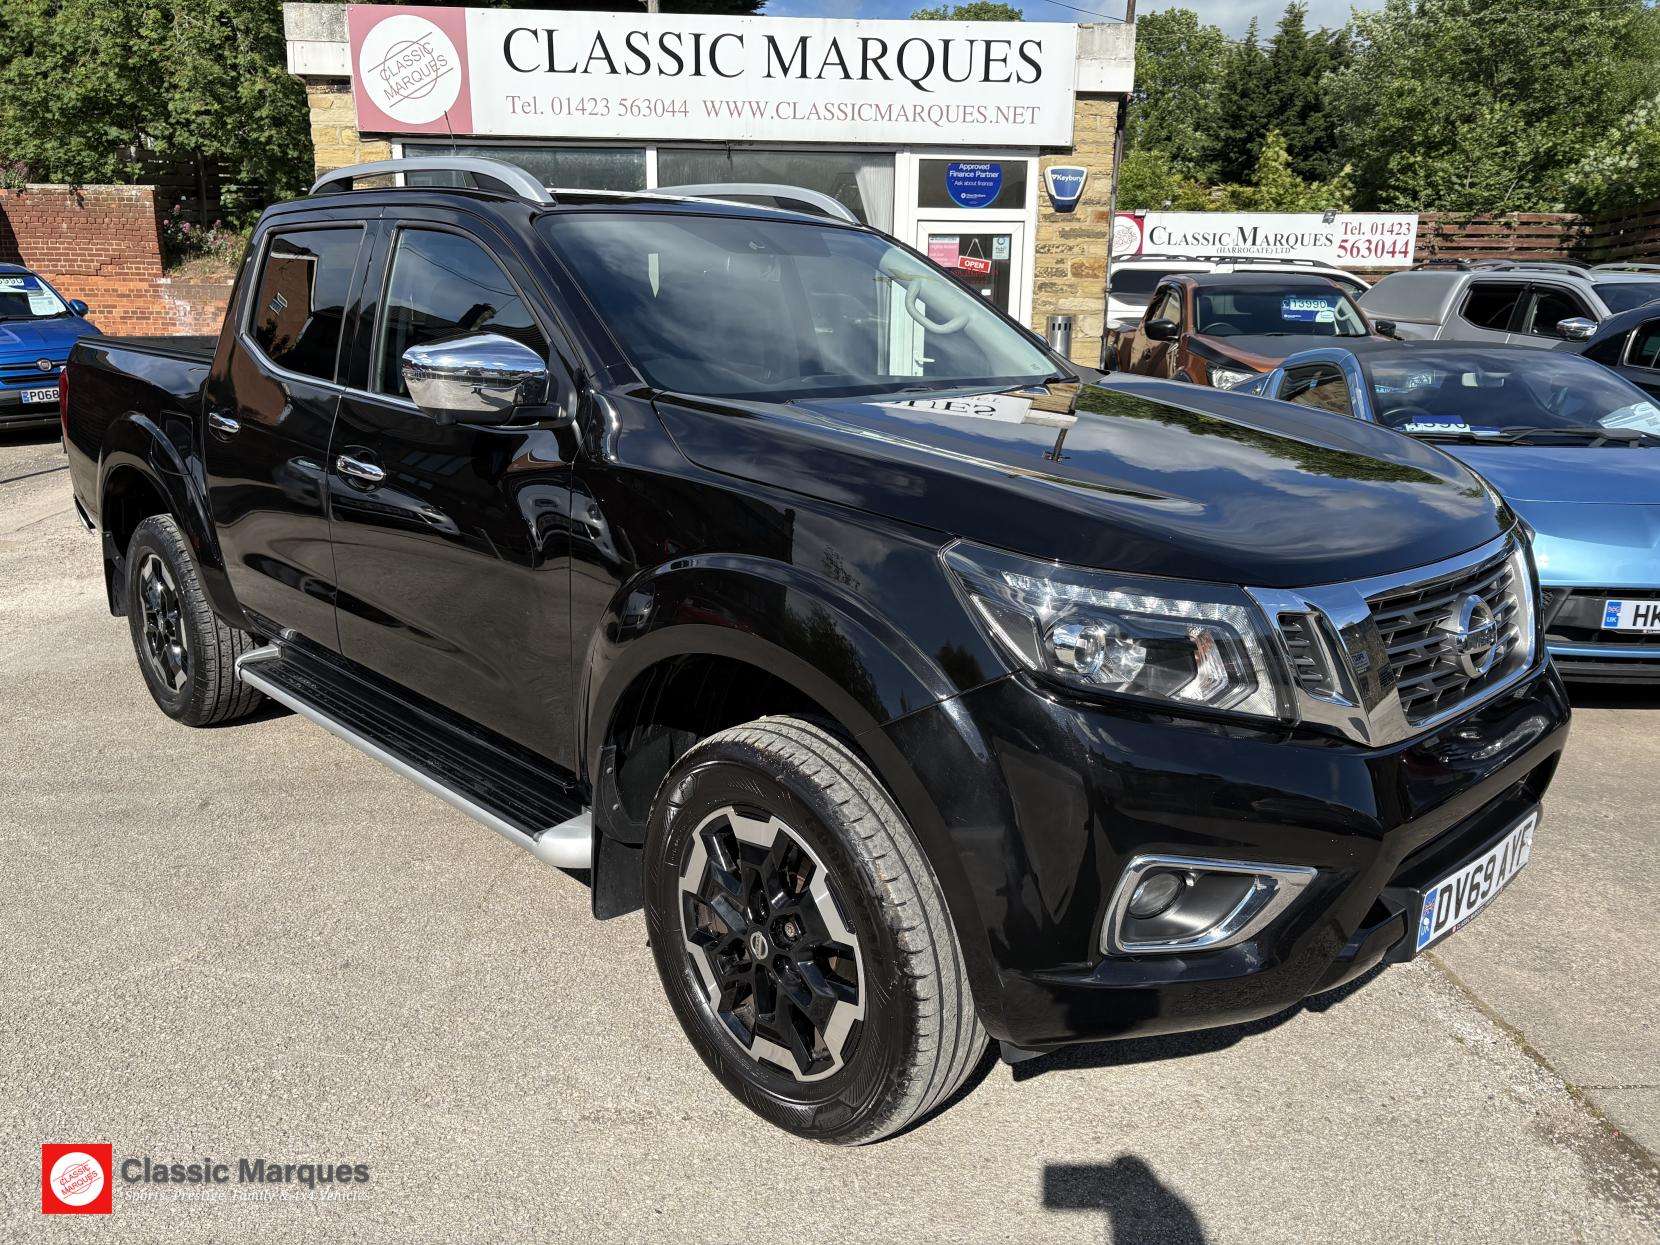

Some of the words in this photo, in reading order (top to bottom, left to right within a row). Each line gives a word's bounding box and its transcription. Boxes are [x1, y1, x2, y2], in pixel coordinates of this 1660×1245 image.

[379, 41, 435, 82] CLASSIC
[503, 27, 745, 79] CLASSIC
[762, 34, 1043, 93] MARQUES
[383, 54, 448, 101] MARQUES
[505, 95, 544, 115] Tel.
[551, 96, 611, 117] 01423
[618, 97, 690, 119] 563044
[702, 100, 1041, 127] WWW.CLASSICMARQUES.NET
[949, 170, 975, 178] Finance
[1341, 221, 1366, 236] Tel.
[1370, 221, 1411, 236] 01423
[1216, 247, 1273, 255] (HARROGATE)
[1274, 247, 1291, 255] LTD
[1336, 239, 1410, 259] 563044
[964, 260, 985, 269] OPEN
[1434, 853, 1497, 935] DV69
[1496, 820, 1533, 888] AYF
